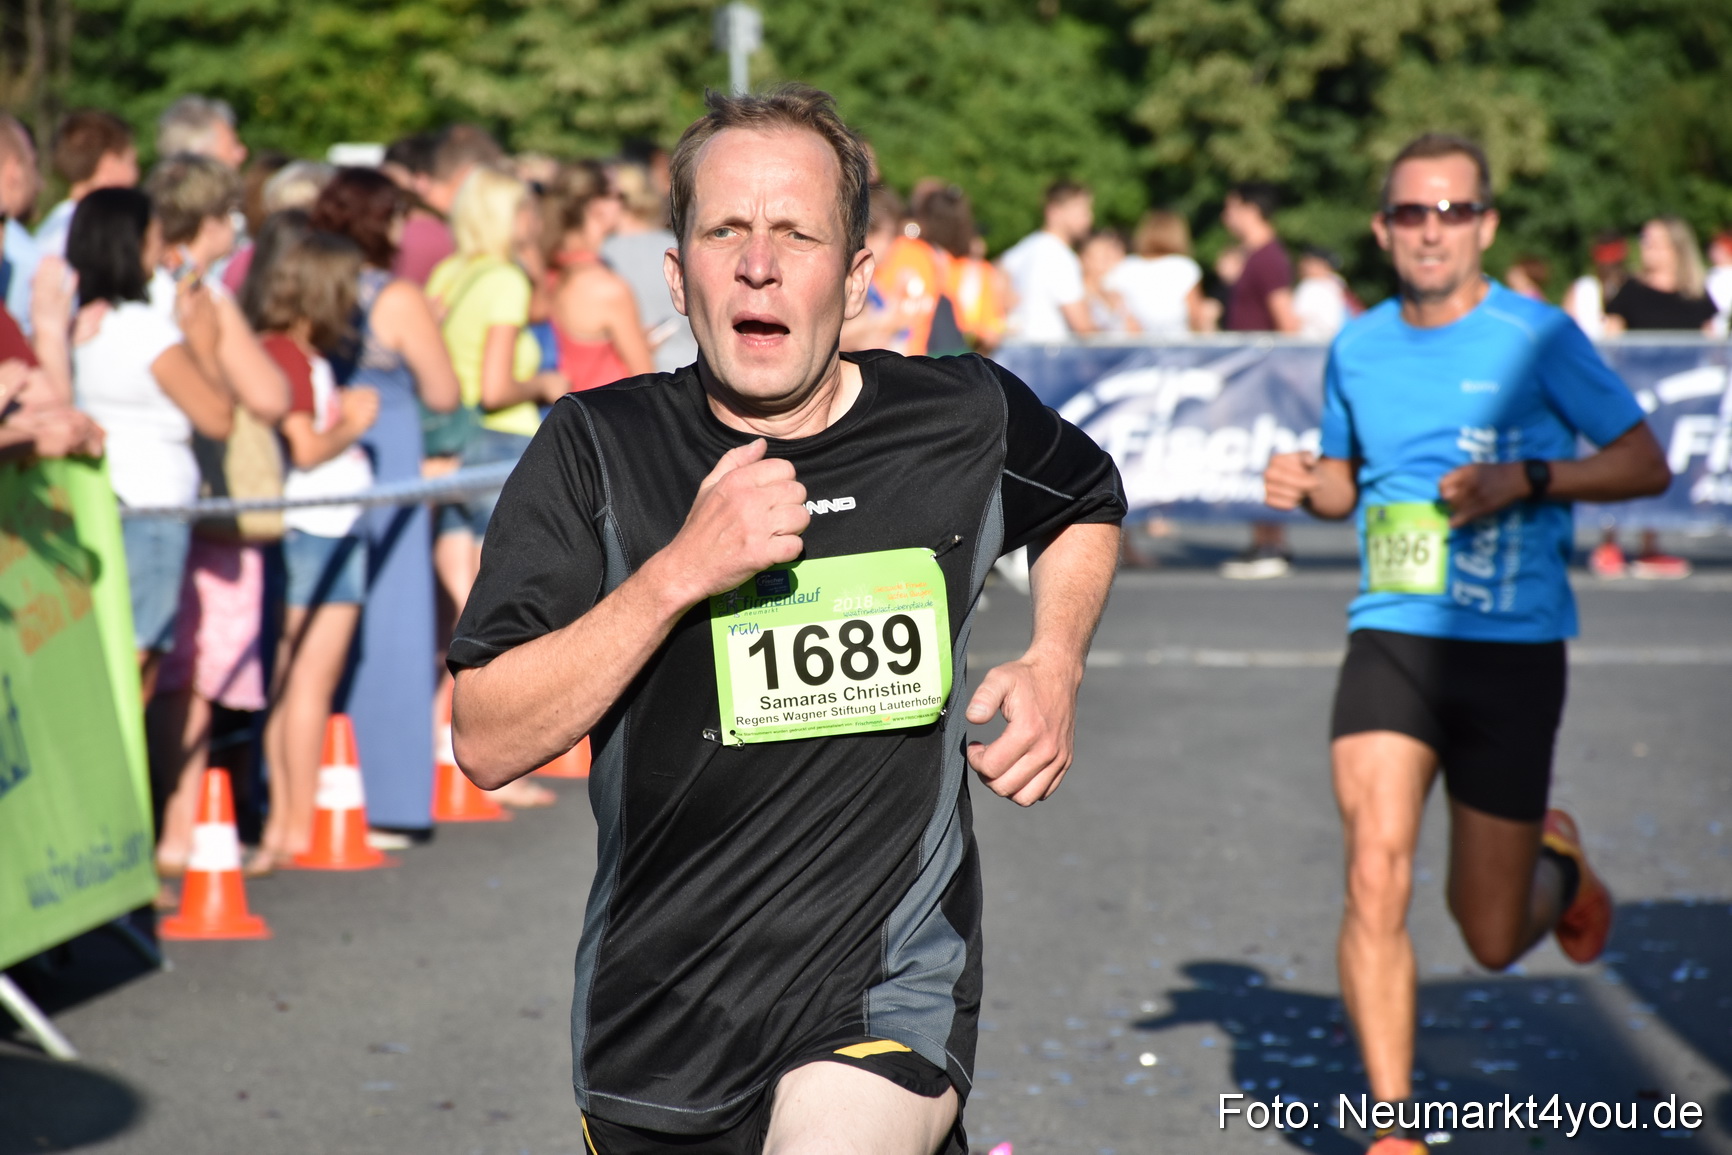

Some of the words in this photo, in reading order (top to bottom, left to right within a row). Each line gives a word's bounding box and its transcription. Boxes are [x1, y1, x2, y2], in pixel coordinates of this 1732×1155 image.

[1106, 413, 1322, 474] Fische
[803, 496, 856, 515] NNO
[744, 586, 821, 609] firmenlauf
[832, 594, 874, 613] 2018
[744, 607, 778, 616] neumarkt
[748, 613, 922, 690] 1689
[760, 692, 837, 710] Samaras
[843, 680, 921, 701] Christine
[736, 715, 779, 727] Regens
[783, 709, 827, 722] Wagner
[831, 704, 876, 717] Stiftung
[880, 695, 942, 711] Lauterhofen
